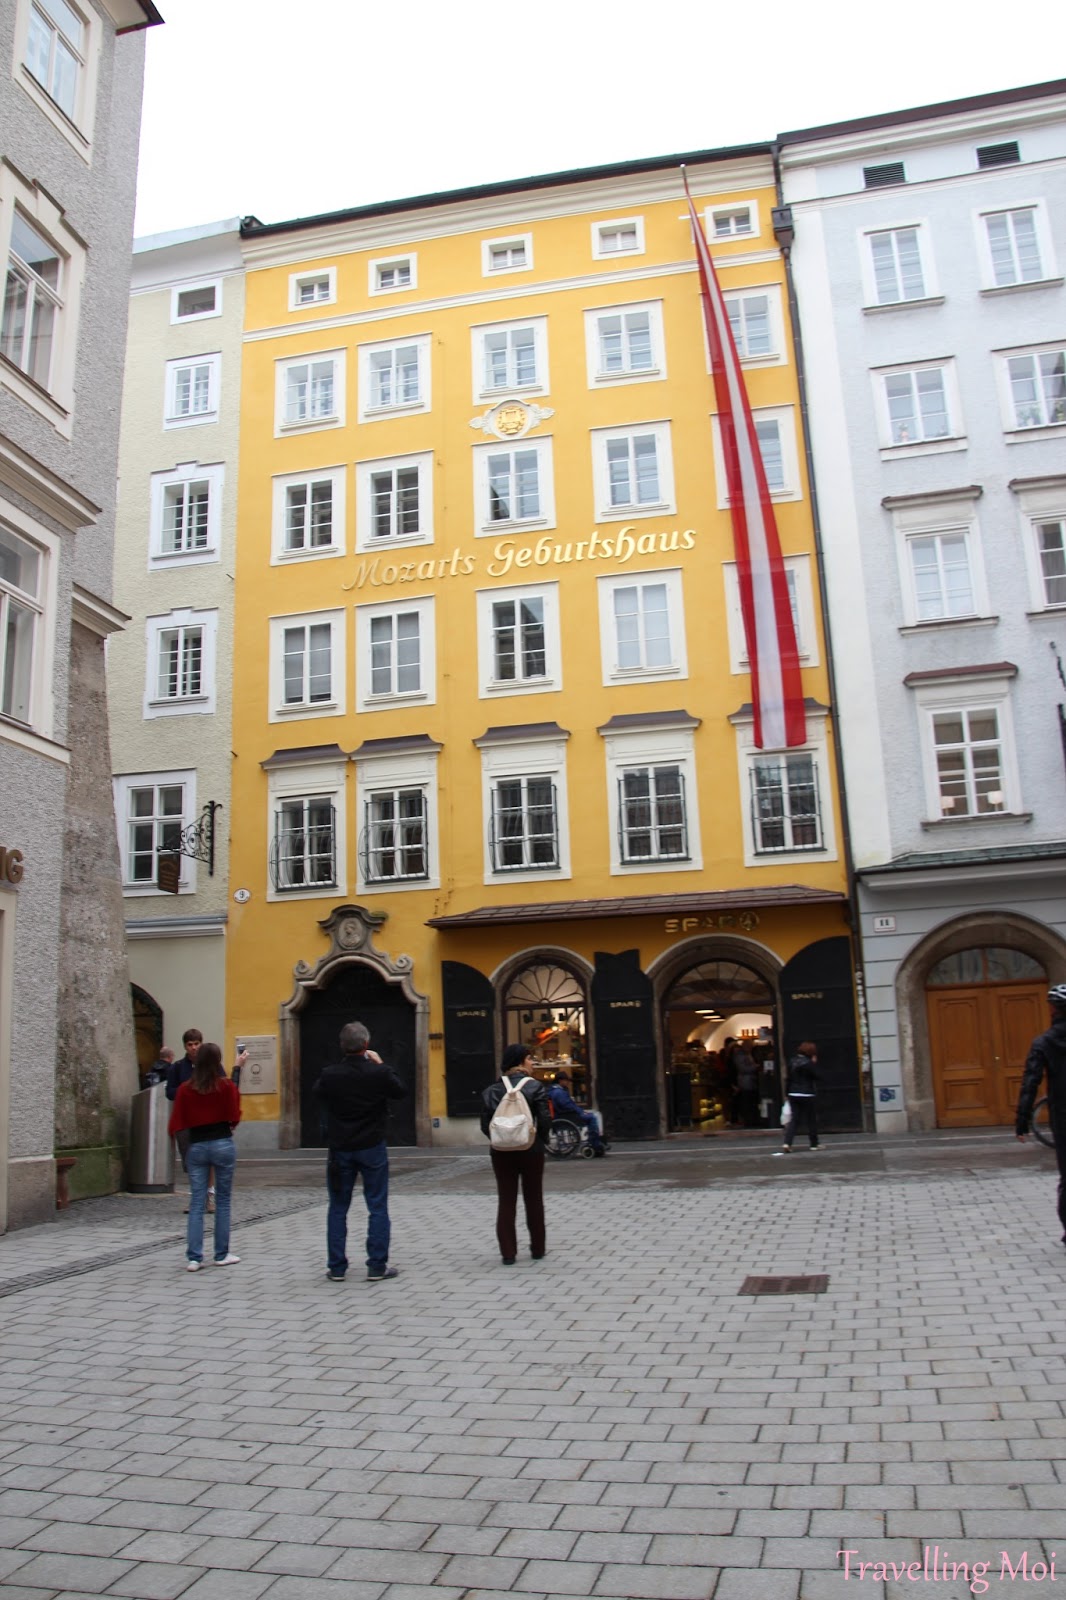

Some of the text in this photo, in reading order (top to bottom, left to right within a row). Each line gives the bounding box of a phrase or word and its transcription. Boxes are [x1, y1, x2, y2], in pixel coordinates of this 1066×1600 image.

[341, 526, 697, 591] Mozarts Geburtshaus
[664, 915, 738, 933] SPAR
[879, 918, 890, 927] 11
